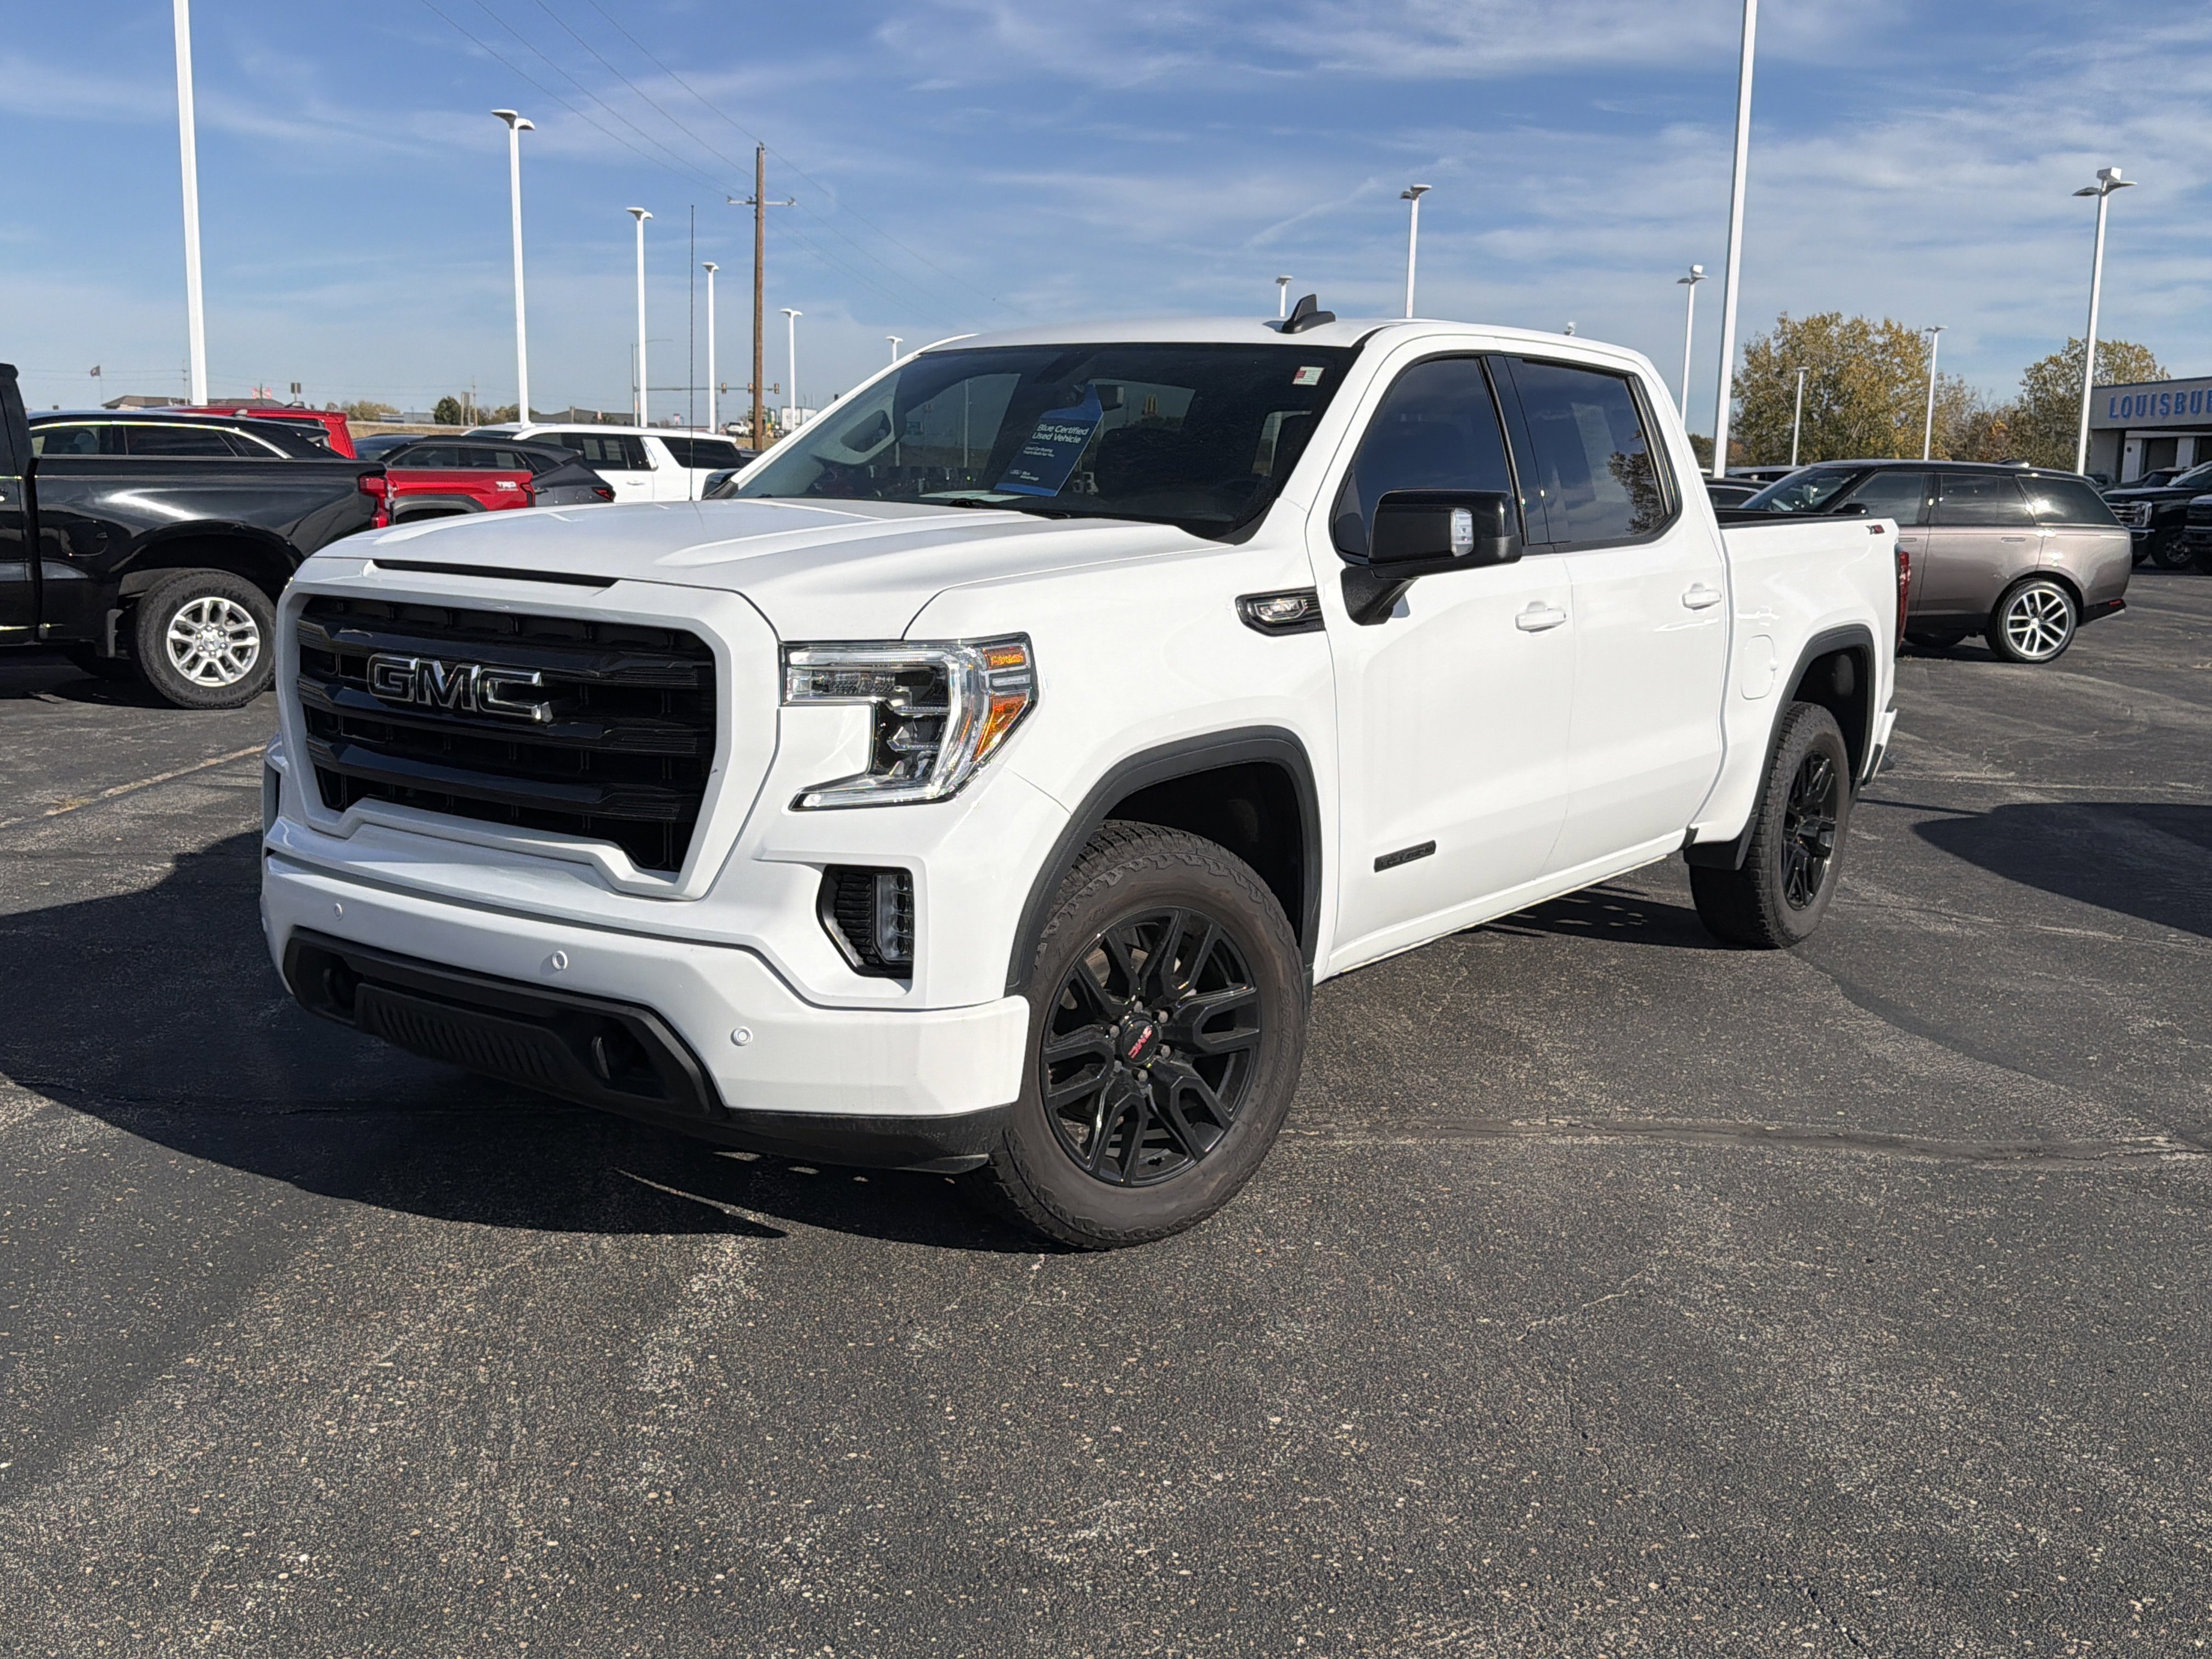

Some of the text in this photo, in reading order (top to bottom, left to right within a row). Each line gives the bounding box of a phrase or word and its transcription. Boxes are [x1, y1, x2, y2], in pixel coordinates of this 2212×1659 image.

[1037, 424, 1089, 435] Blue Certified
[1054, 433, 1081, 443] Vehicle
[367, 652, 553, 723] GMC
[1128, 1025, 1153, 1059] GMC
